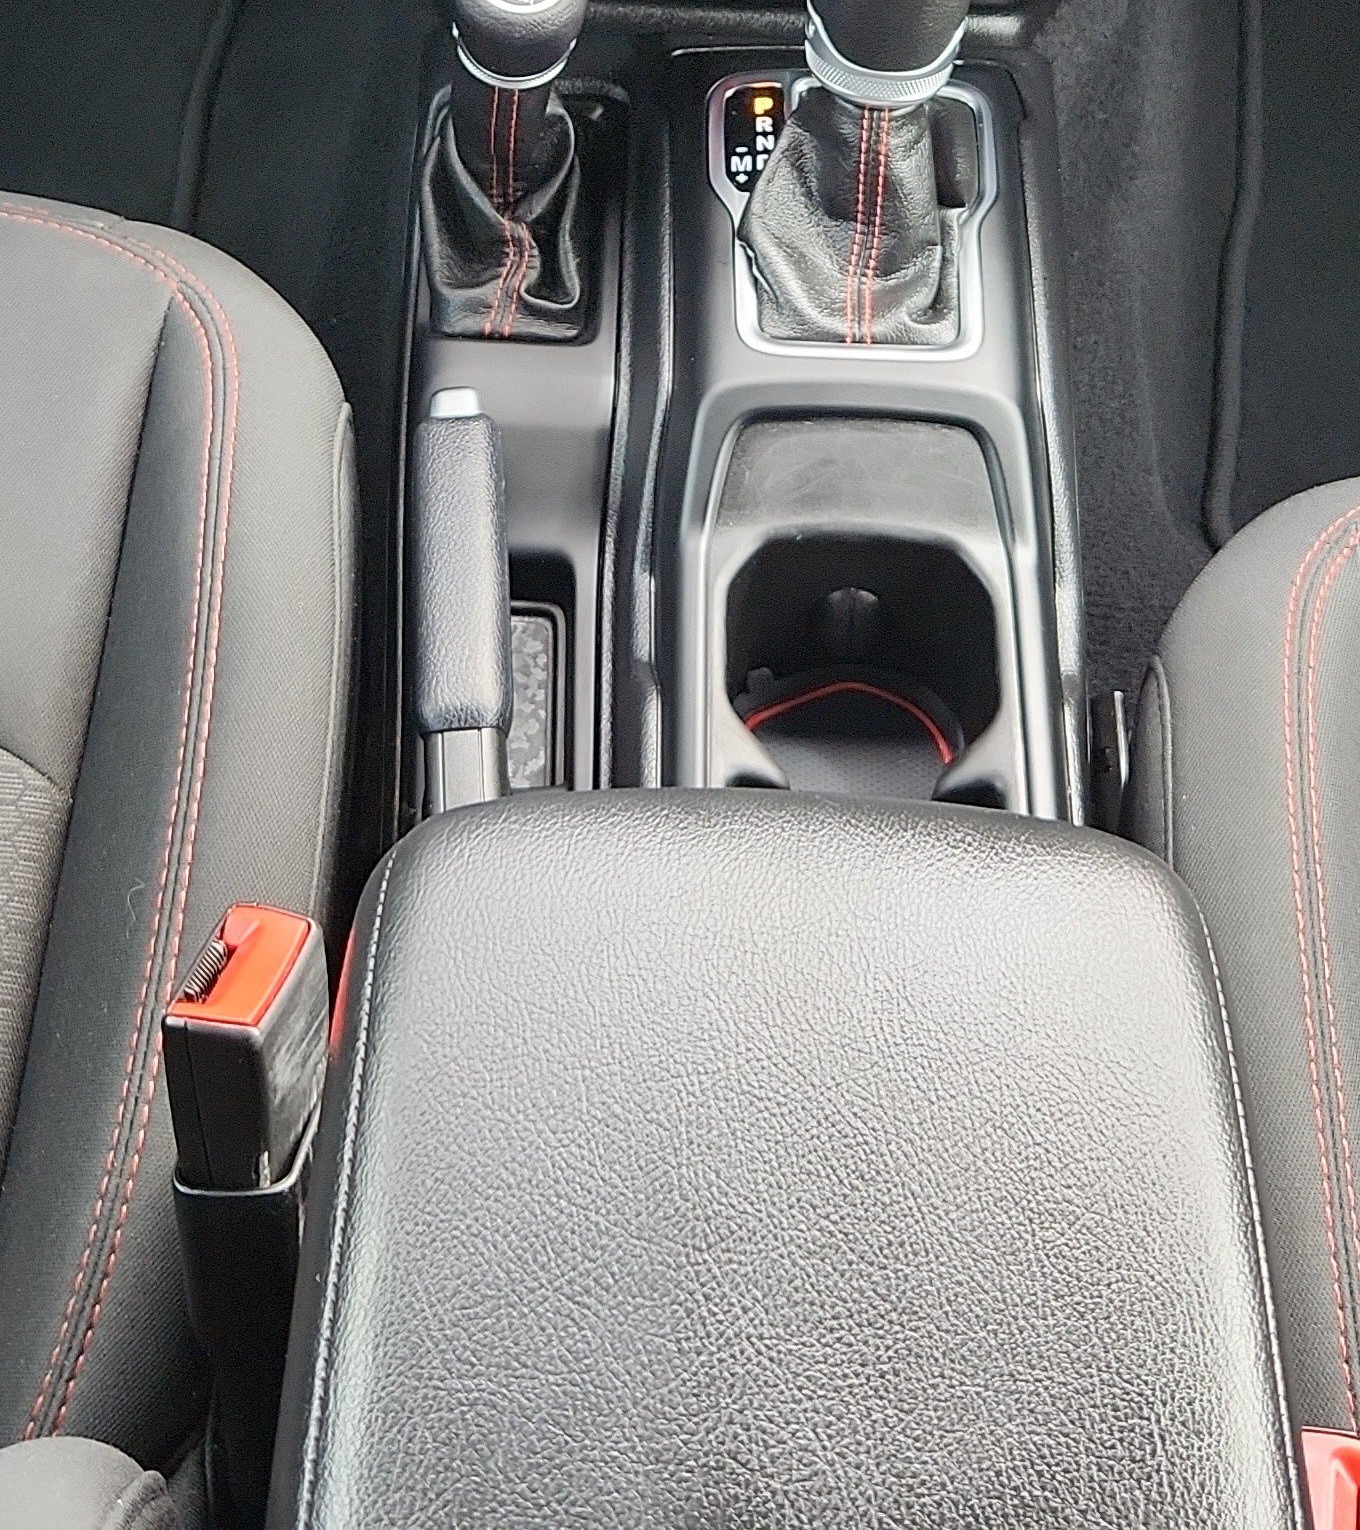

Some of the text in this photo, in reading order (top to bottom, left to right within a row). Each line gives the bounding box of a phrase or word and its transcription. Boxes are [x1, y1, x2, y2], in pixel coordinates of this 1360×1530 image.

[754, 97, 774, 115] P
[755, 116, 773, 133] R
[756, 134, 775, 152] N
[730, 155, 753, 172] M
